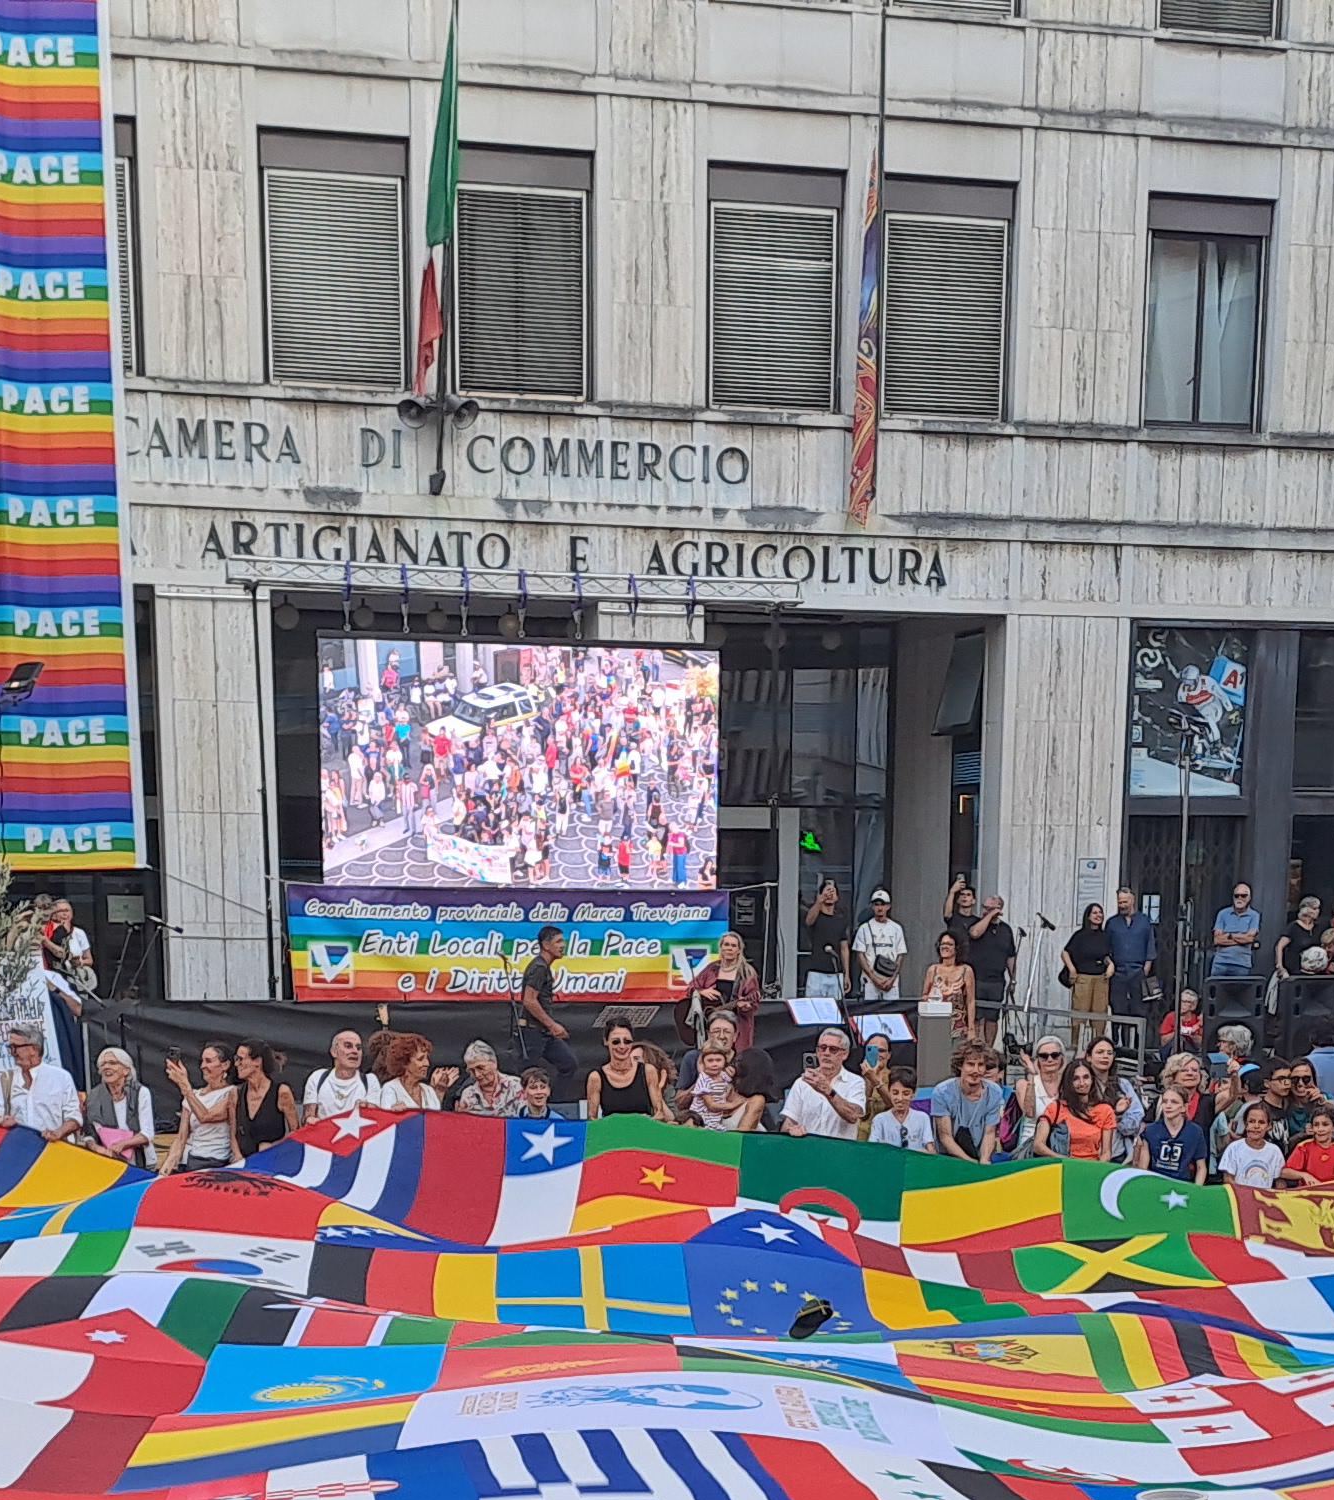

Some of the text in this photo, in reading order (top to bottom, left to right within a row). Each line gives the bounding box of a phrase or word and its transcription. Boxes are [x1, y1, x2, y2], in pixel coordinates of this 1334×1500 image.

[2, 383, 90, 414] PACE
[360, 428, 402, 468] DI
[467, 434, 749, 485] COMMERCIO
[8, 497, 95, 527] PACE
[200, 520, 947, 586] ARTIGIANATO E AGRICOLTURA
[14, 608, 100, 638] PACE
[20, 718, 106, 747] PACE
[24, 826, 112, 853] PACE
[307, 899, 711, 923] Coordinamento provinciale della Marca Trevigiana
[361, 929, 661, 962] Enti Locali pe la Pace
[400, 974, 416, 991] e
[426, 969, 438, 992] i
[448, 968, 523, 993] Diritt
